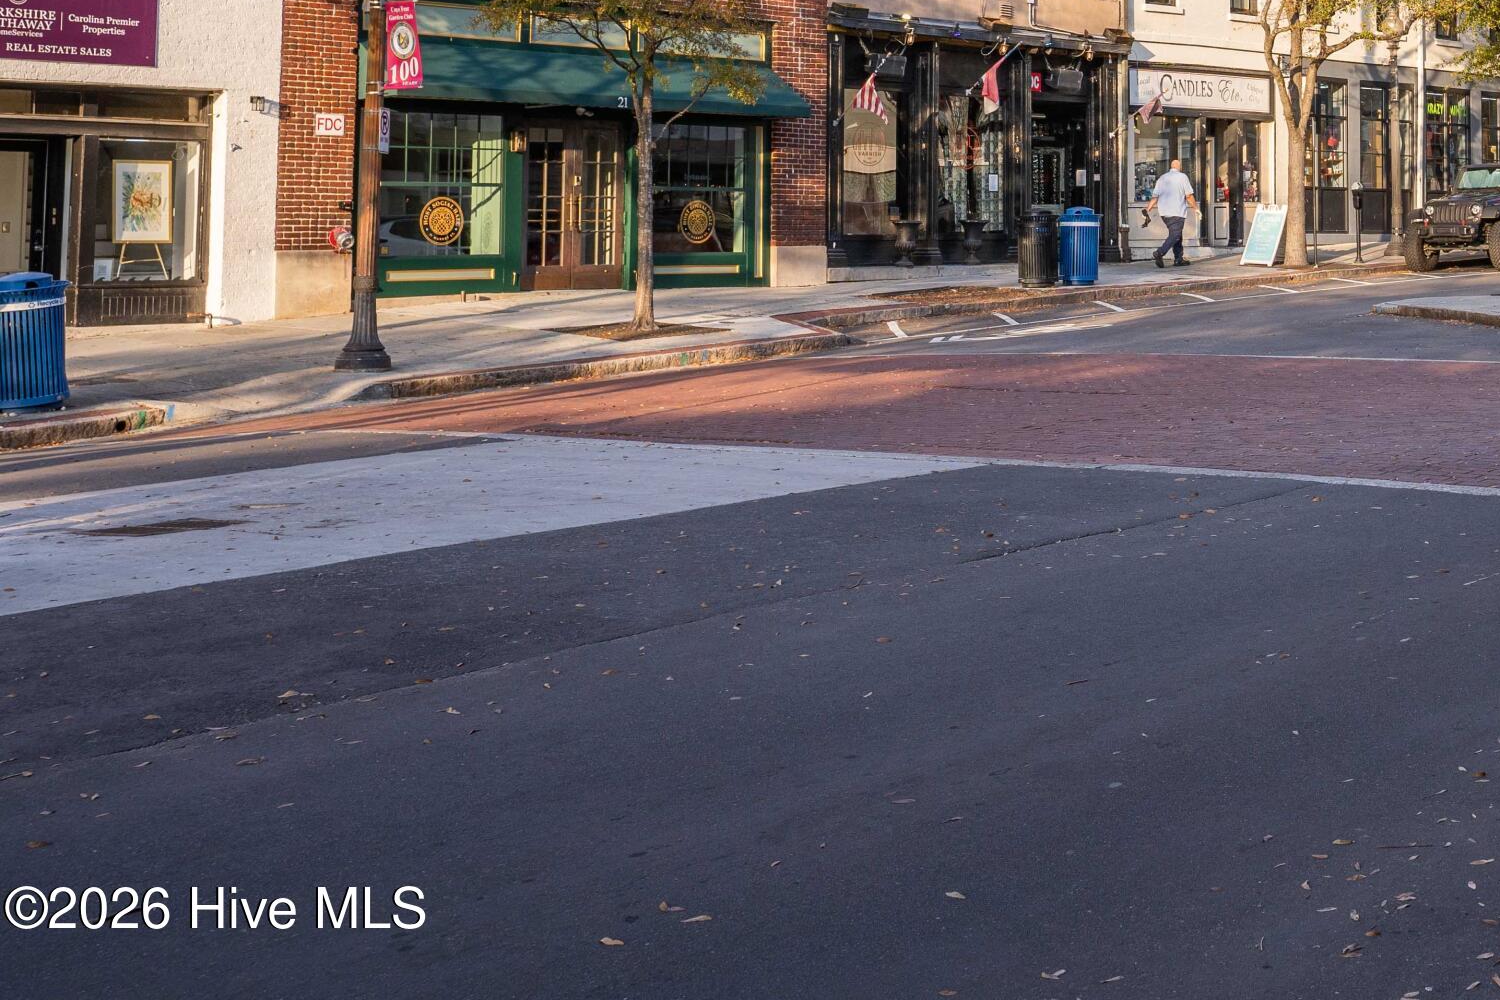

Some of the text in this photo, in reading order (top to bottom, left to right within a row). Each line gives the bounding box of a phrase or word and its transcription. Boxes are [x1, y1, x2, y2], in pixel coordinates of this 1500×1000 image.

[68, 13, 140, 27] Carolina Premier
[82, 25, 126, 36] Properties
[6, 42, 112, 57] REAL ESTATE SALES
[389, 56, 419, 85] 100
[1160, 74, 1213, 101] CANDLES
[617, 96, 628, 108] 21
[317, 118, 342, 131] FDC
[423, 206, 432, 226] HOST
[431, 200, 454, 210] SOCIAL
